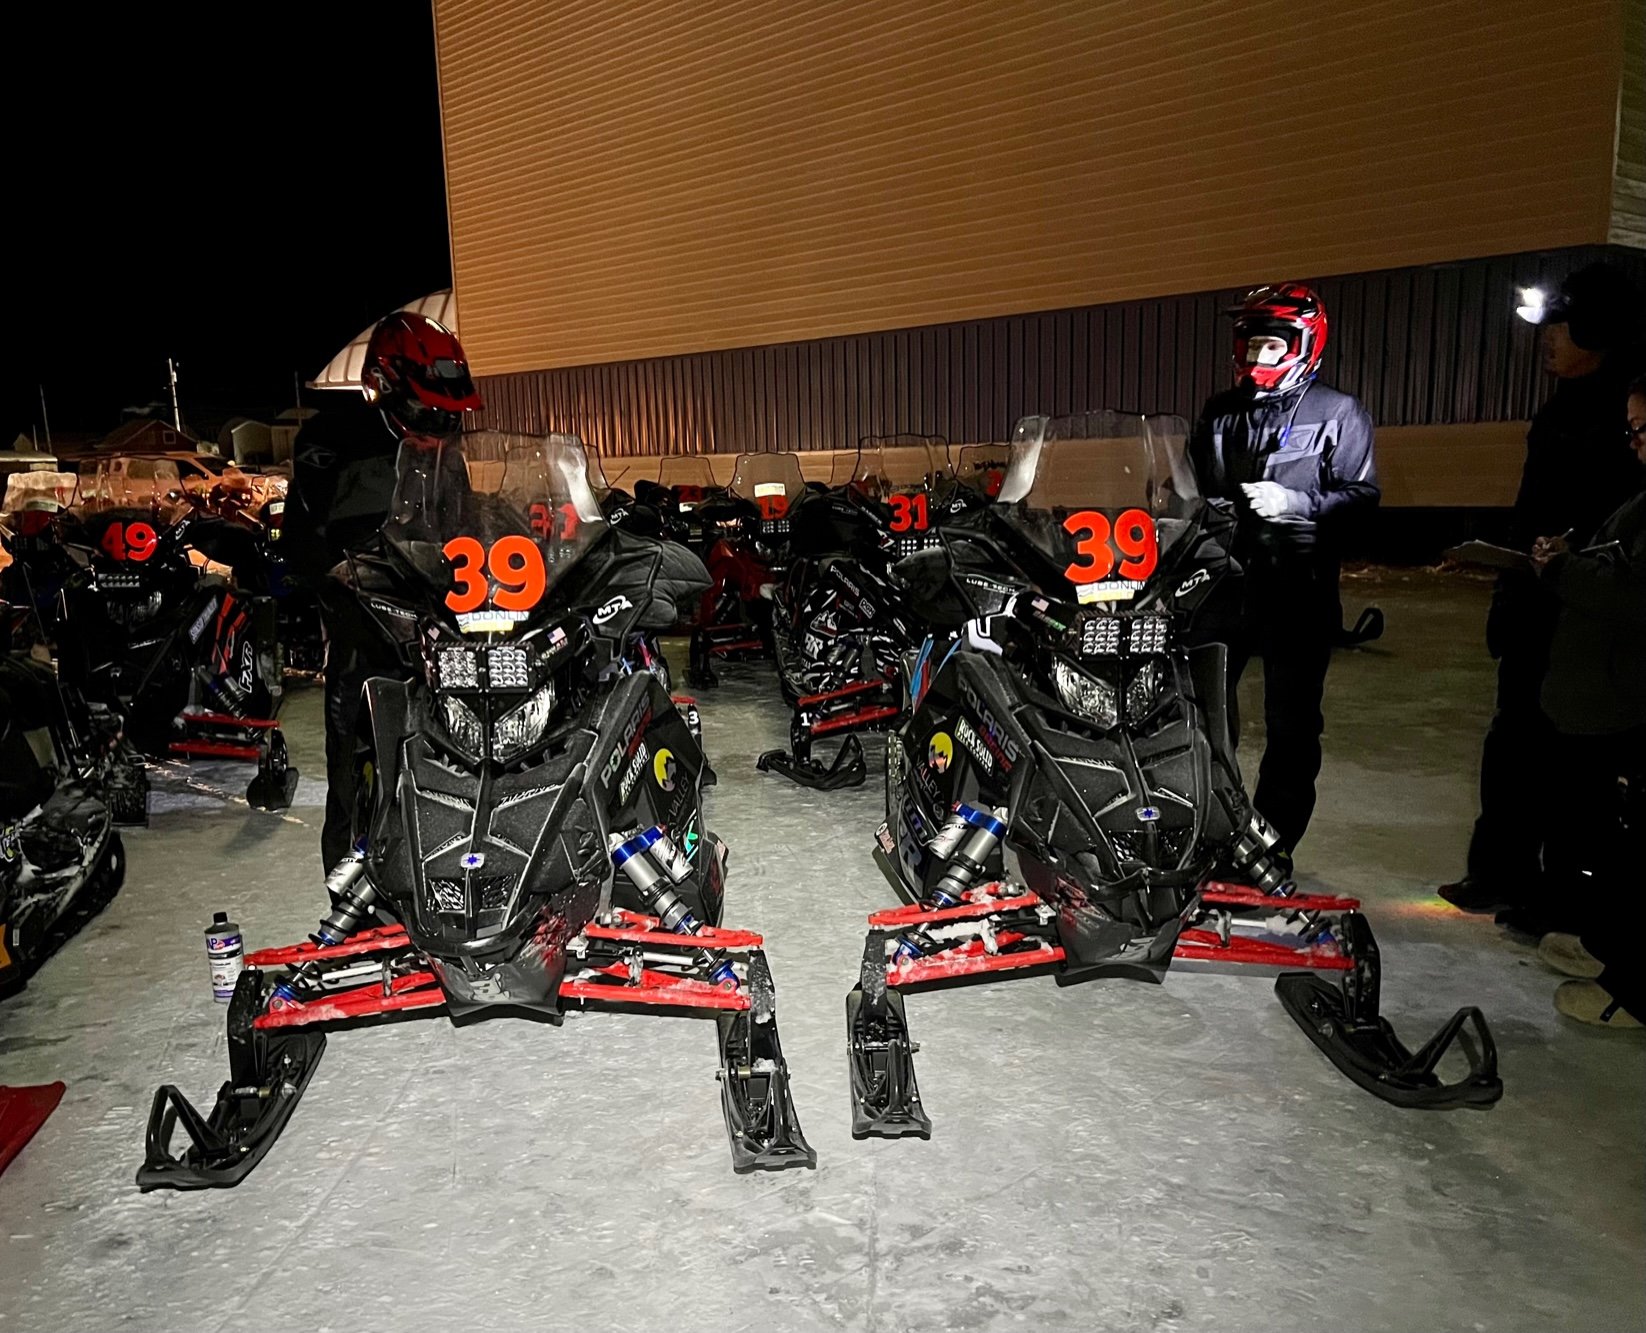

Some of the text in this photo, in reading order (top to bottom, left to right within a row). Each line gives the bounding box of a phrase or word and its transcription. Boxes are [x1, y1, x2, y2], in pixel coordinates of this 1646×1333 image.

[888, 492, 928, 532] 31
[102, 522, 158, 561] 49
[1062, 508, 1158, 584] 39
[441, 535, 546, 614] 39
[830, 565, 860, 596] POLARIS
[1178, 571, 1210, 593] MTA
[595, 598, 633, 620] MTA
[958, 673, 1017, 762] POLARIS
[600, 690, 650, 790] POLARIS
